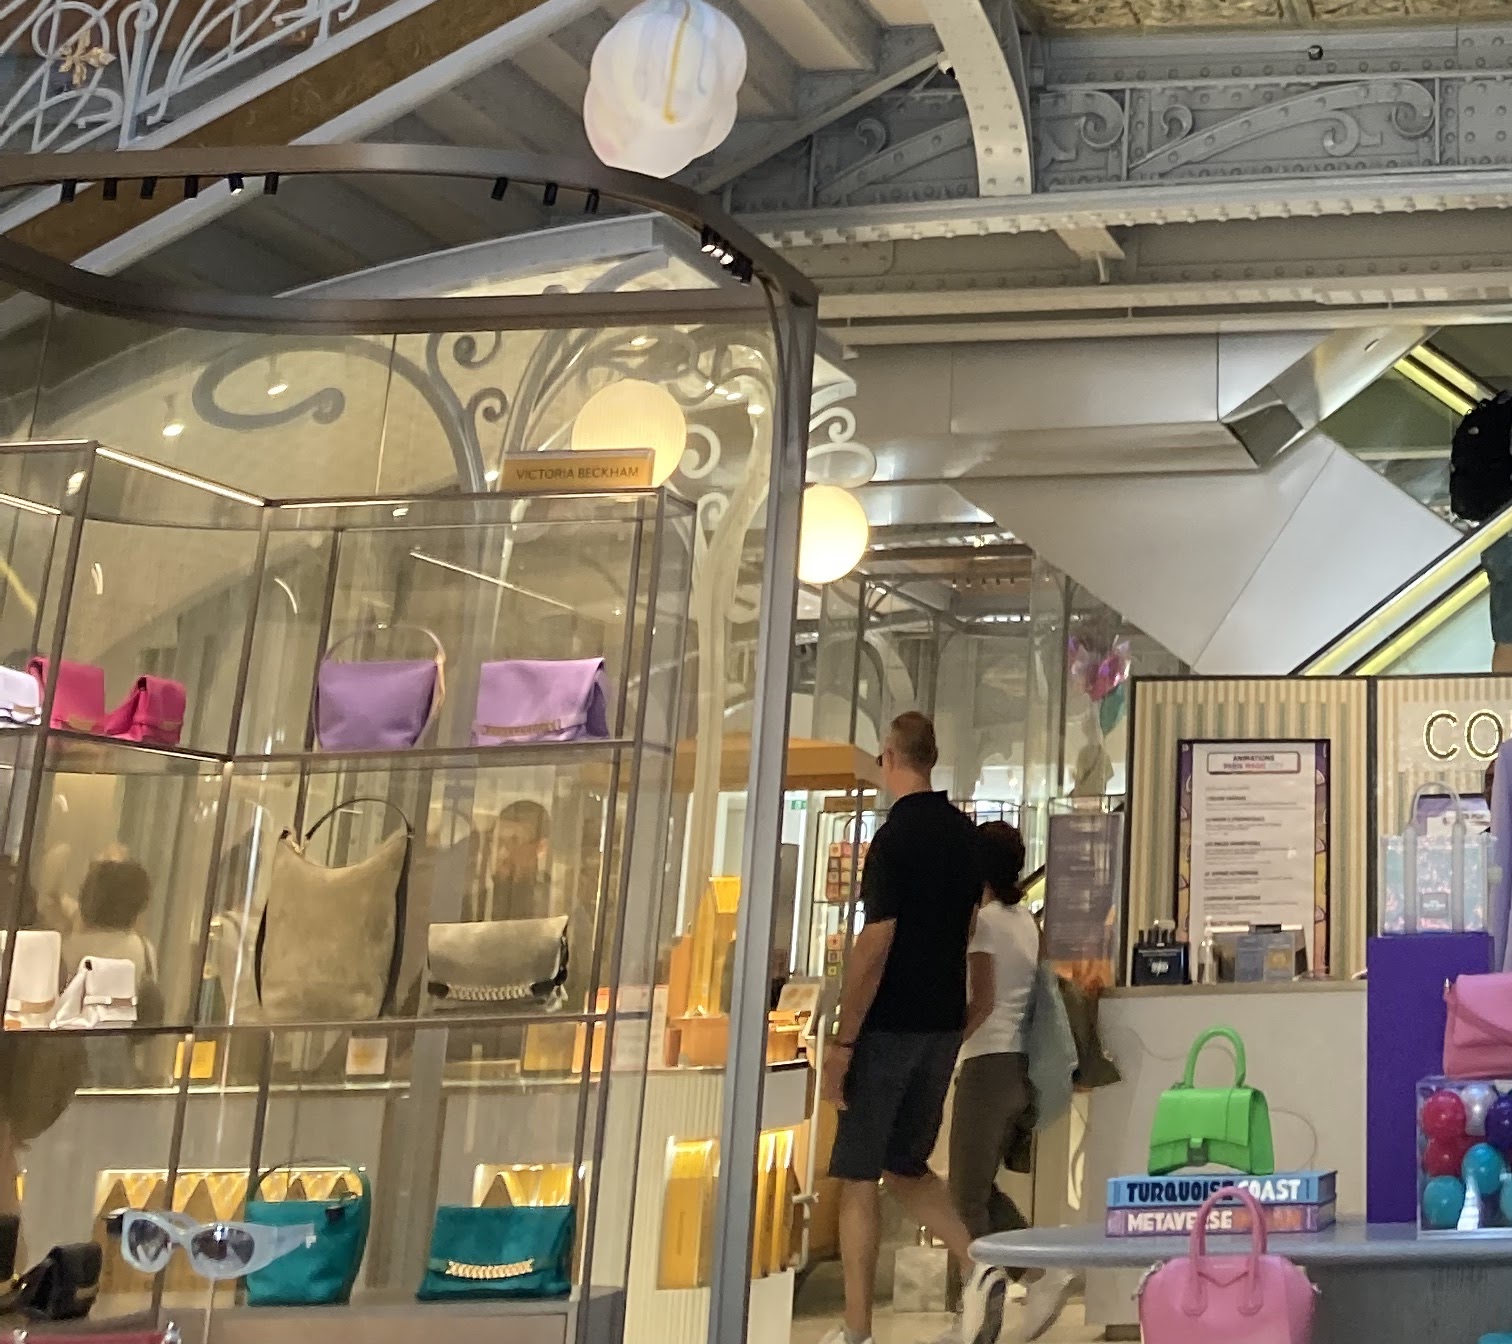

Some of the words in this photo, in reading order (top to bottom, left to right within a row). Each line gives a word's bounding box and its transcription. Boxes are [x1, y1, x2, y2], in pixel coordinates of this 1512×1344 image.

[516, 468, 574, 481] VICTORIA
[577, 467, 640, 479] BECKHAM
[1127, 1180, 1235, 1203] TURQUOISE
[1127, 1210, 1233, 1233] METAVESE
